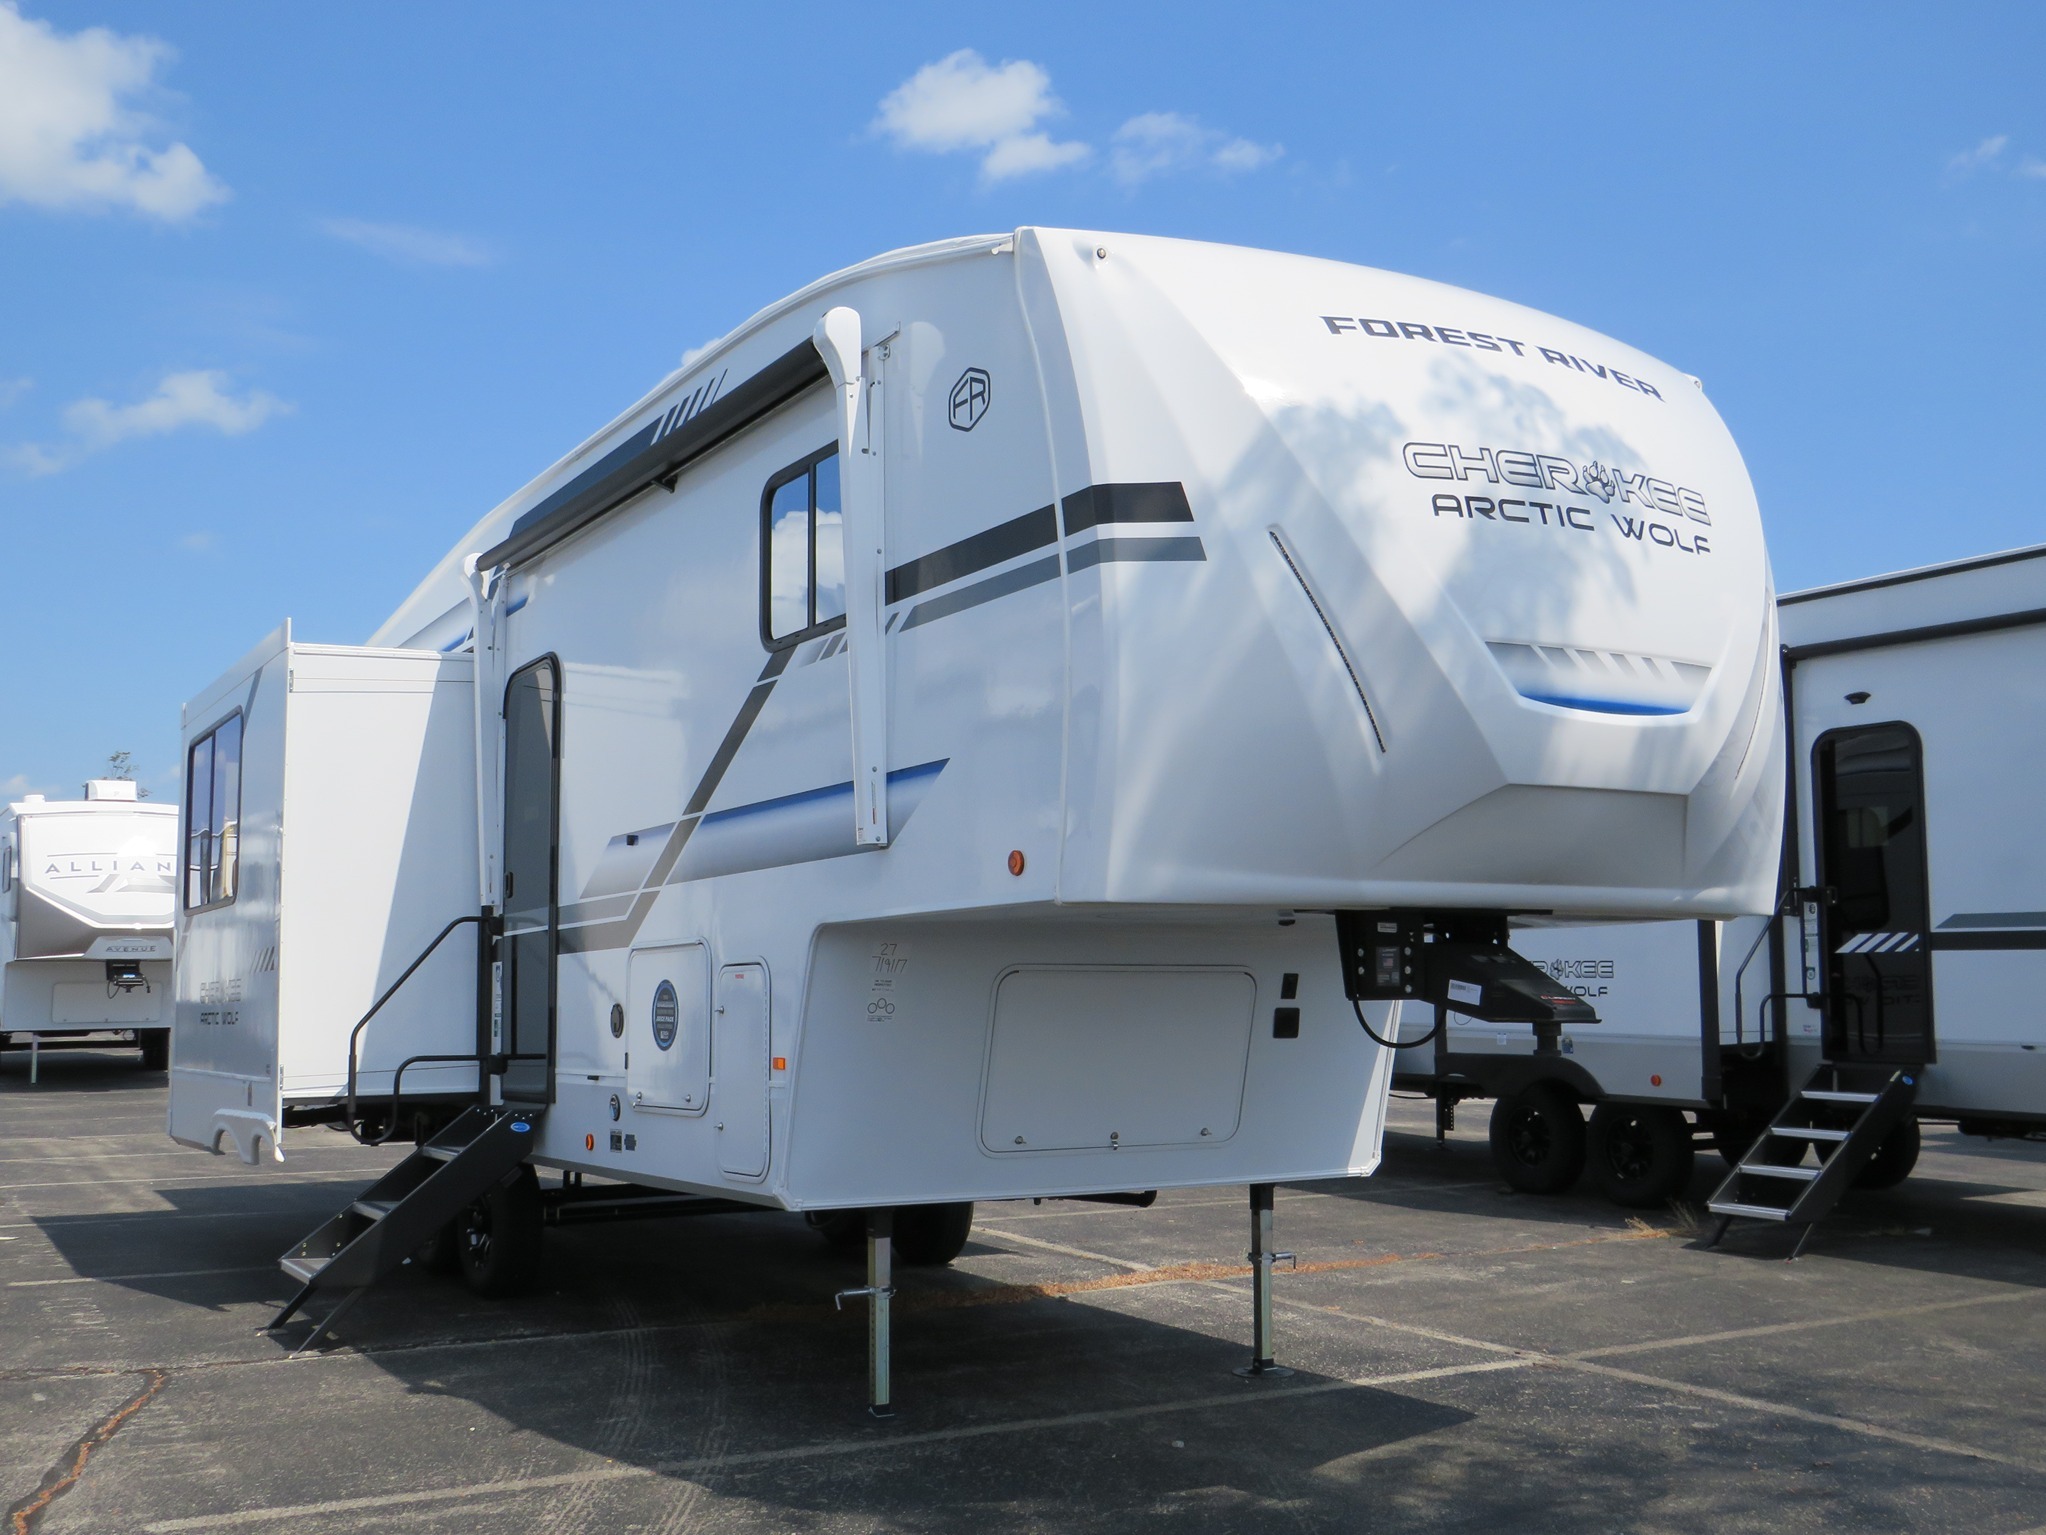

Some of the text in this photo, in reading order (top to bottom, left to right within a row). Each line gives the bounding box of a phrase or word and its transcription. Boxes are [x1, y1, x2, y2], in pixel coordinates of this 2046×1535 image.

[1319, 315, 1666, 403] FOREST RIVER
[1431, 493, 1711, 554] ARCTIC WOLF
[880, 942, 898, 956] 27
